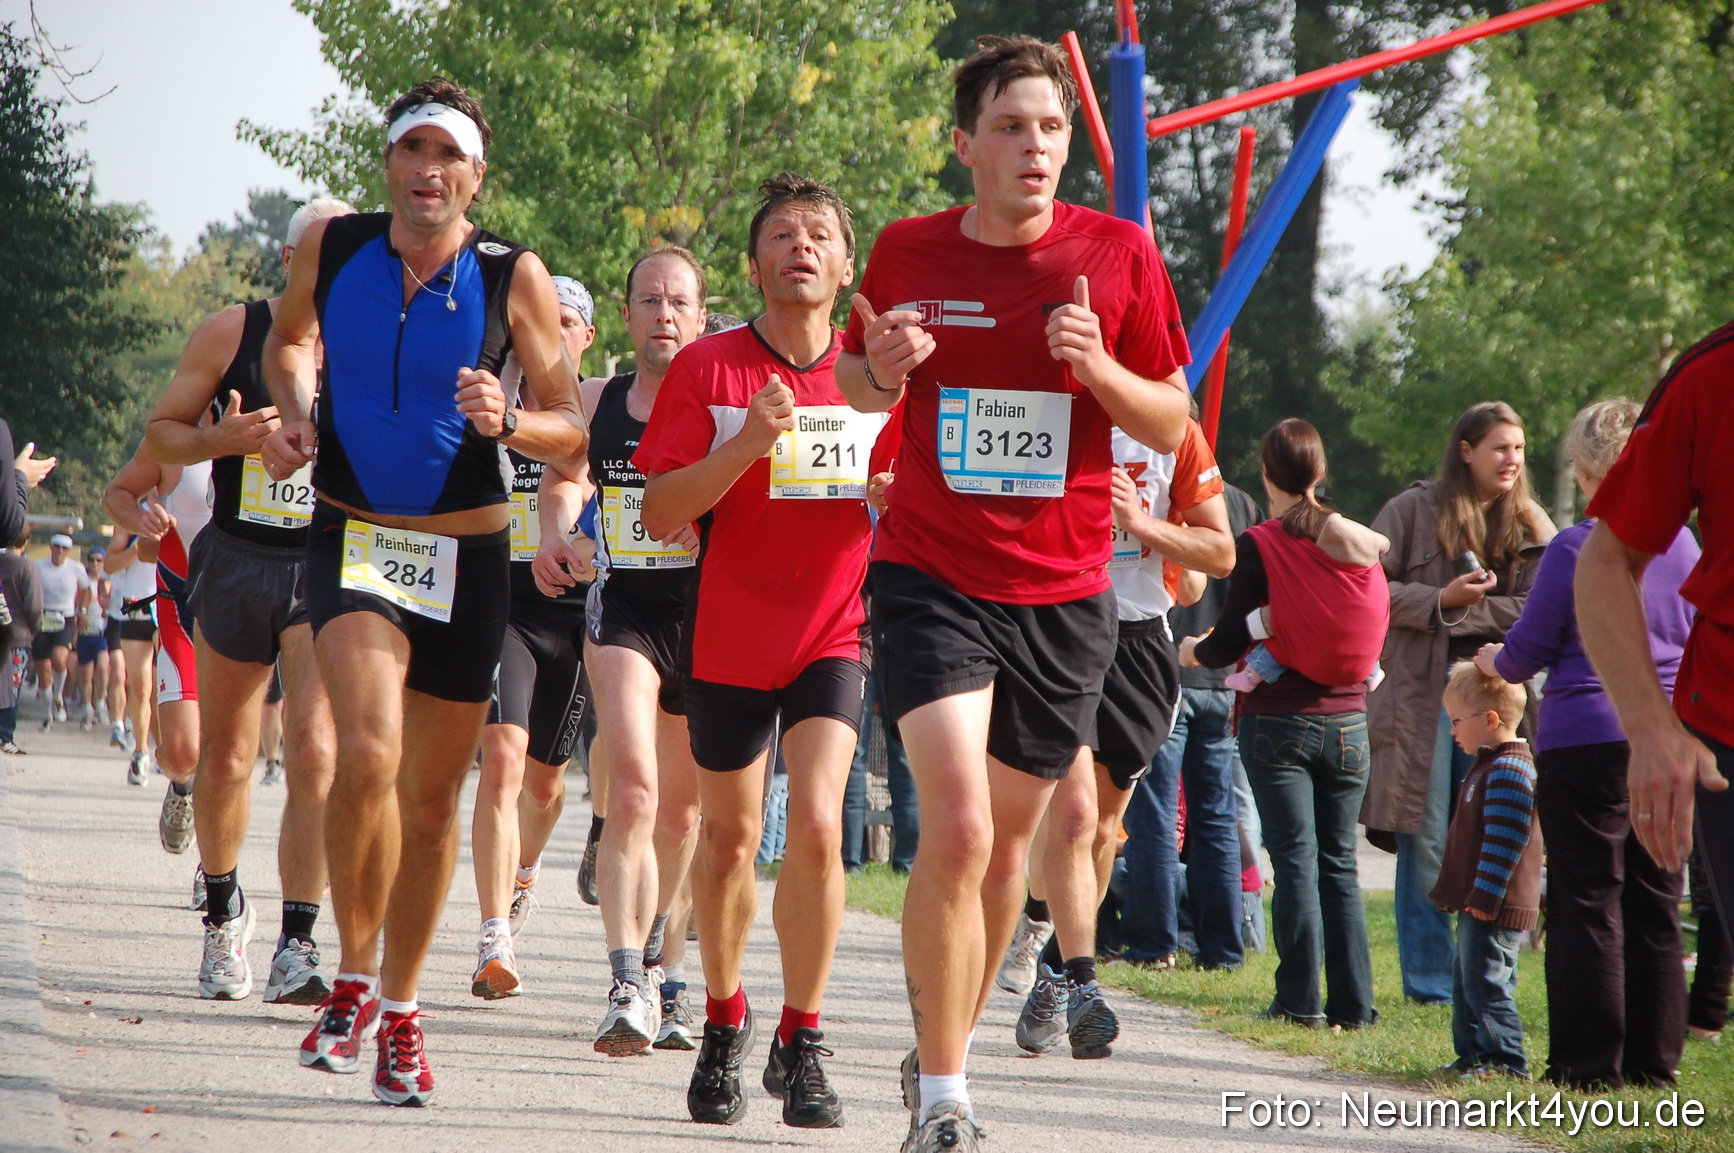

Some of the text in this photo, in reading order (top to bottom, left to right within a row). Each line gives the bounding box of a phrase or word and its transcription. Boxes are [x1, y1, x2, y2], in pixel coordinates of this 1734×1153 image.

[975, 398, 1027, 419] Fabian
[798, 415, 846, 432] Günter
[946, 426, 955, 440] B
[775, 442, 783, 456] B
[975, 428, 1054, 459] 3123
[811, 442, 857, 468] 211
[602, 460, 624, 469] LLC
[605, 517, 611, 529] B
[375, 532, 438, 557] Reinhard
[348, 549, 356, 558] A
[383, 559, 436, 591] 284
